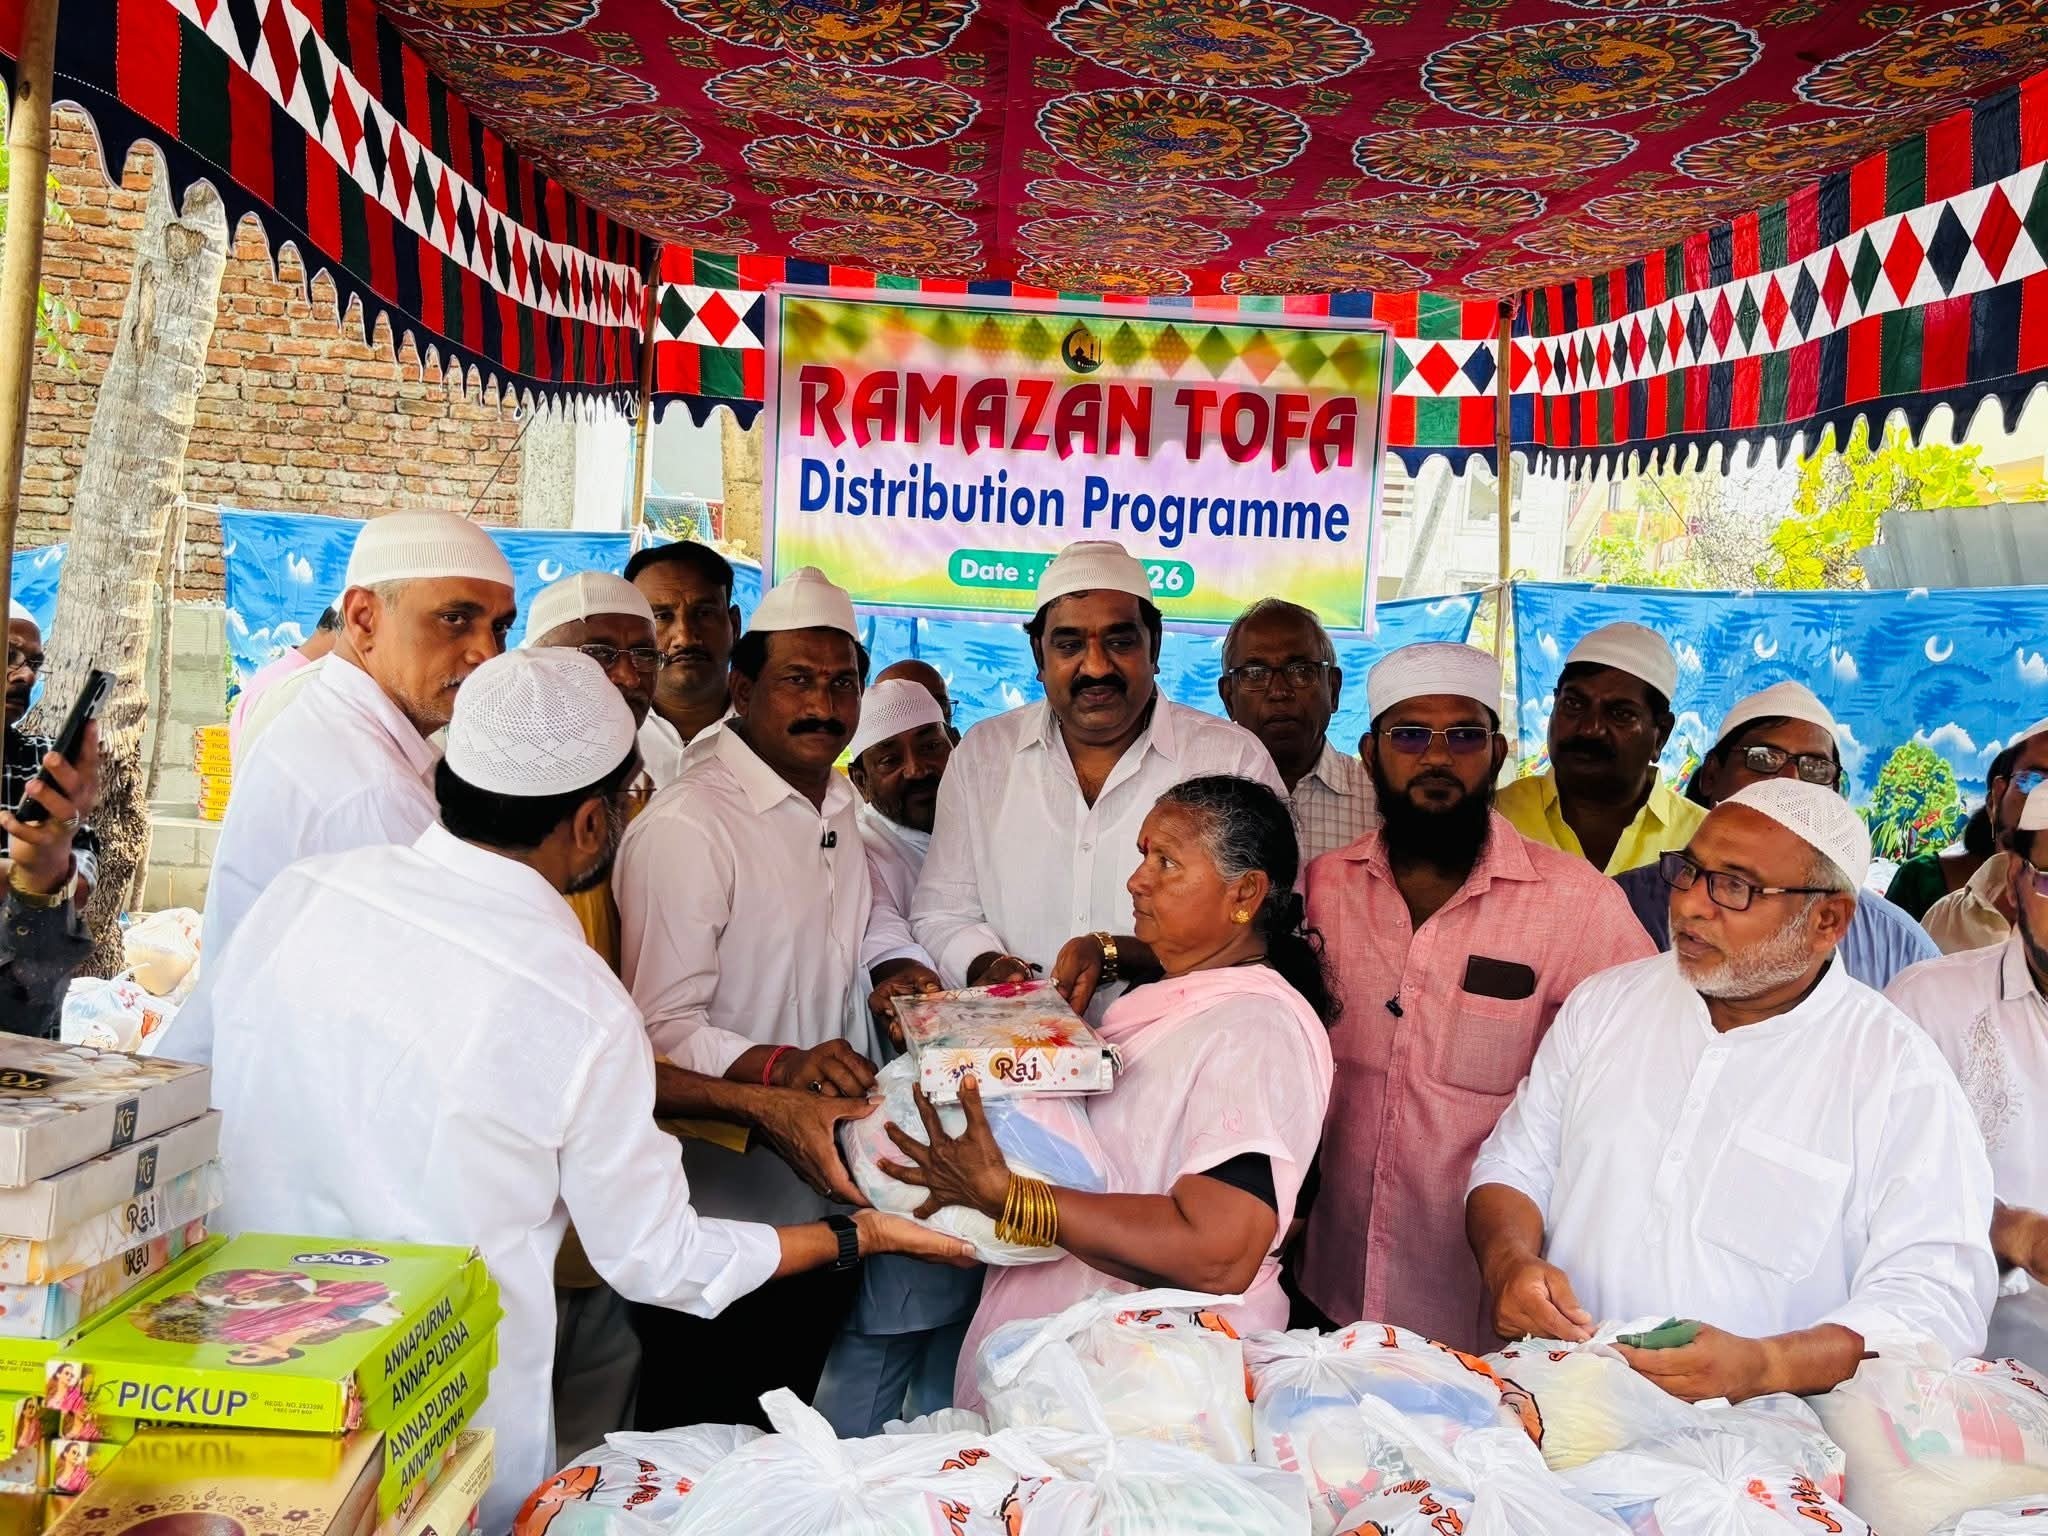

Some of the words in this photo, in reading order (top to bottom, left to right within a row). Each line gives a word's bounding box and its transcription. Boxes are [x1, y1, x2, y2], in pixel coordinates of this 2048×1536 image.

[799, 364, 1154, 461] RAMAZAN
[1174, 387, 1359, 474] TOFA
[800, 457, 1064, 528] Distribution
[1083, 475, 1350, 549] Programme
[960, 558, 1019, 583] Date
[995, 1056, 1038, 1083] Raj
[126, 1195, 156, 1234] Raj
[125, 1244, 150, 1276] Raj
[384, 1295, 453, 1381] ANNAPURNA
[392, 1320, 470, 1411] ANNAPURNA
[390, 1370, 469, 1465] ANNAPURNA
